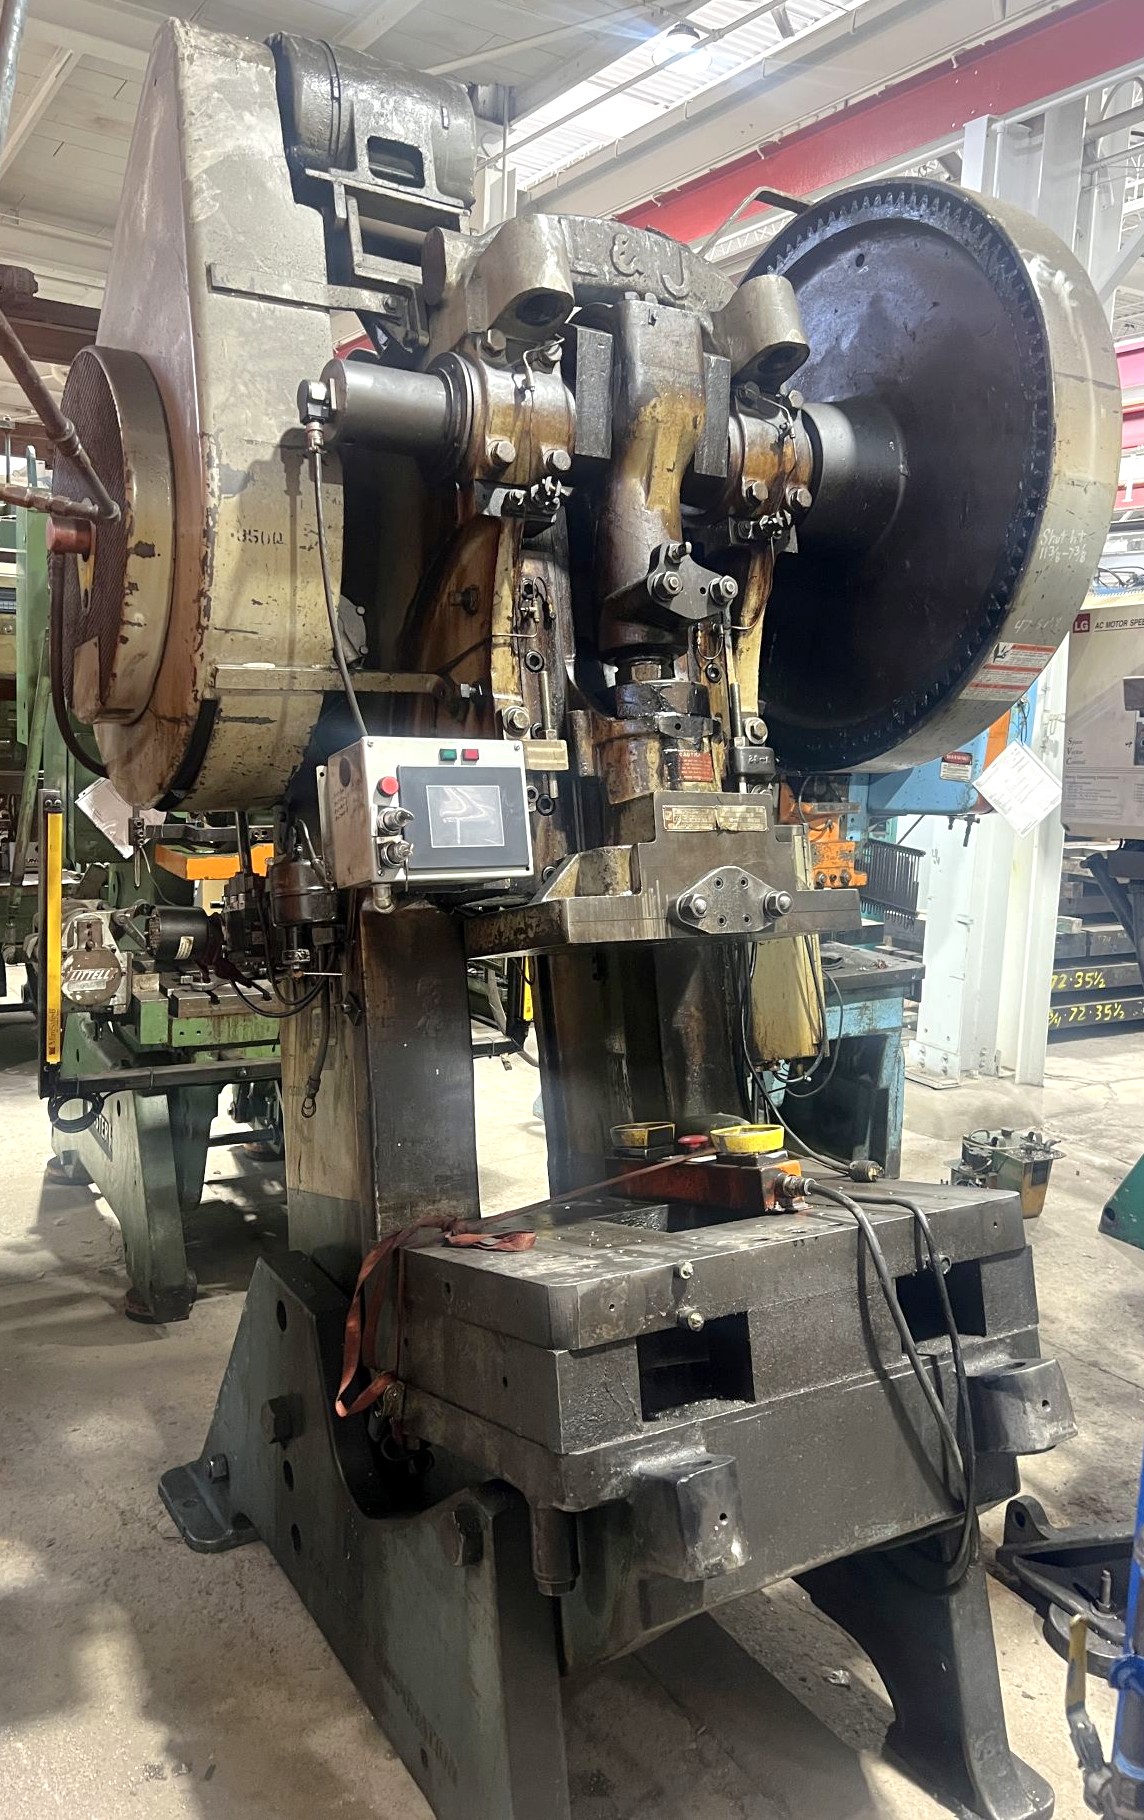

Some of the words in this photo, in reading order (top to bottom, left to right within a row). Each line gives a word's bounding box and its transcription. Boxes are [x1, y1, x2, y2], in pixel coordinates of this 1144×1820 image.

[1074, 620, 1089, 631] LG
[1094, 621, 1104, 629] AC
[1106, 619, 1128, 629] MOTOR
[69, 969, 111, 981] LITTELL
